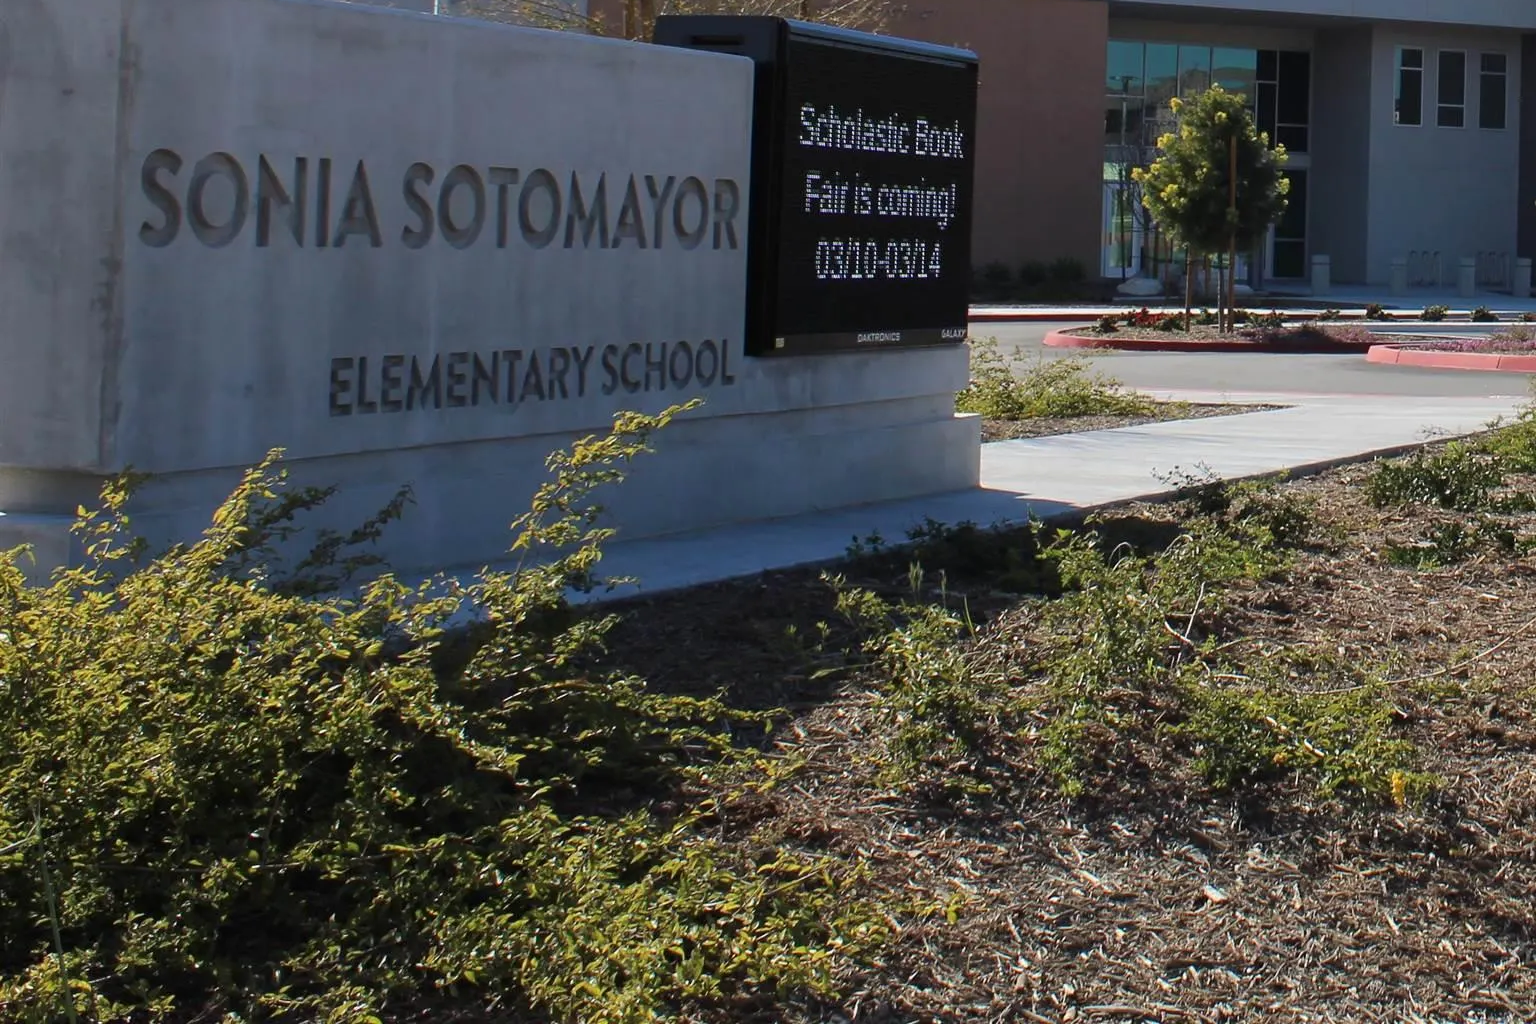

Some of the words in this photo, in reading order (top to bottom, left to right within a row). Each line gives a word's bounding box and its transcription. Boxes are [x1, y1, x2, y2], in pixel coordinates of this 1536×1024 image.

[800, 103, 909, 154] Scholastic
[915, 116, 964, 159] Book
[138, 148, 383, 249] SONIA
[402, 162, 740, 250] SOTOMAYOR
[804, 170, 849, 213] Fair
[854, 172, 872, 215] is
[878, 177, 956, 230] coming!
[815, 237, 941, 279] 03/10-03/14
[857, 332, 901, 343] DAKTRONICS
[941, 328, 966, 339] GALAXY
[329, 345, 594, 417] ELEMENTARY
[602, 339, 736, 396] SCHOOL
